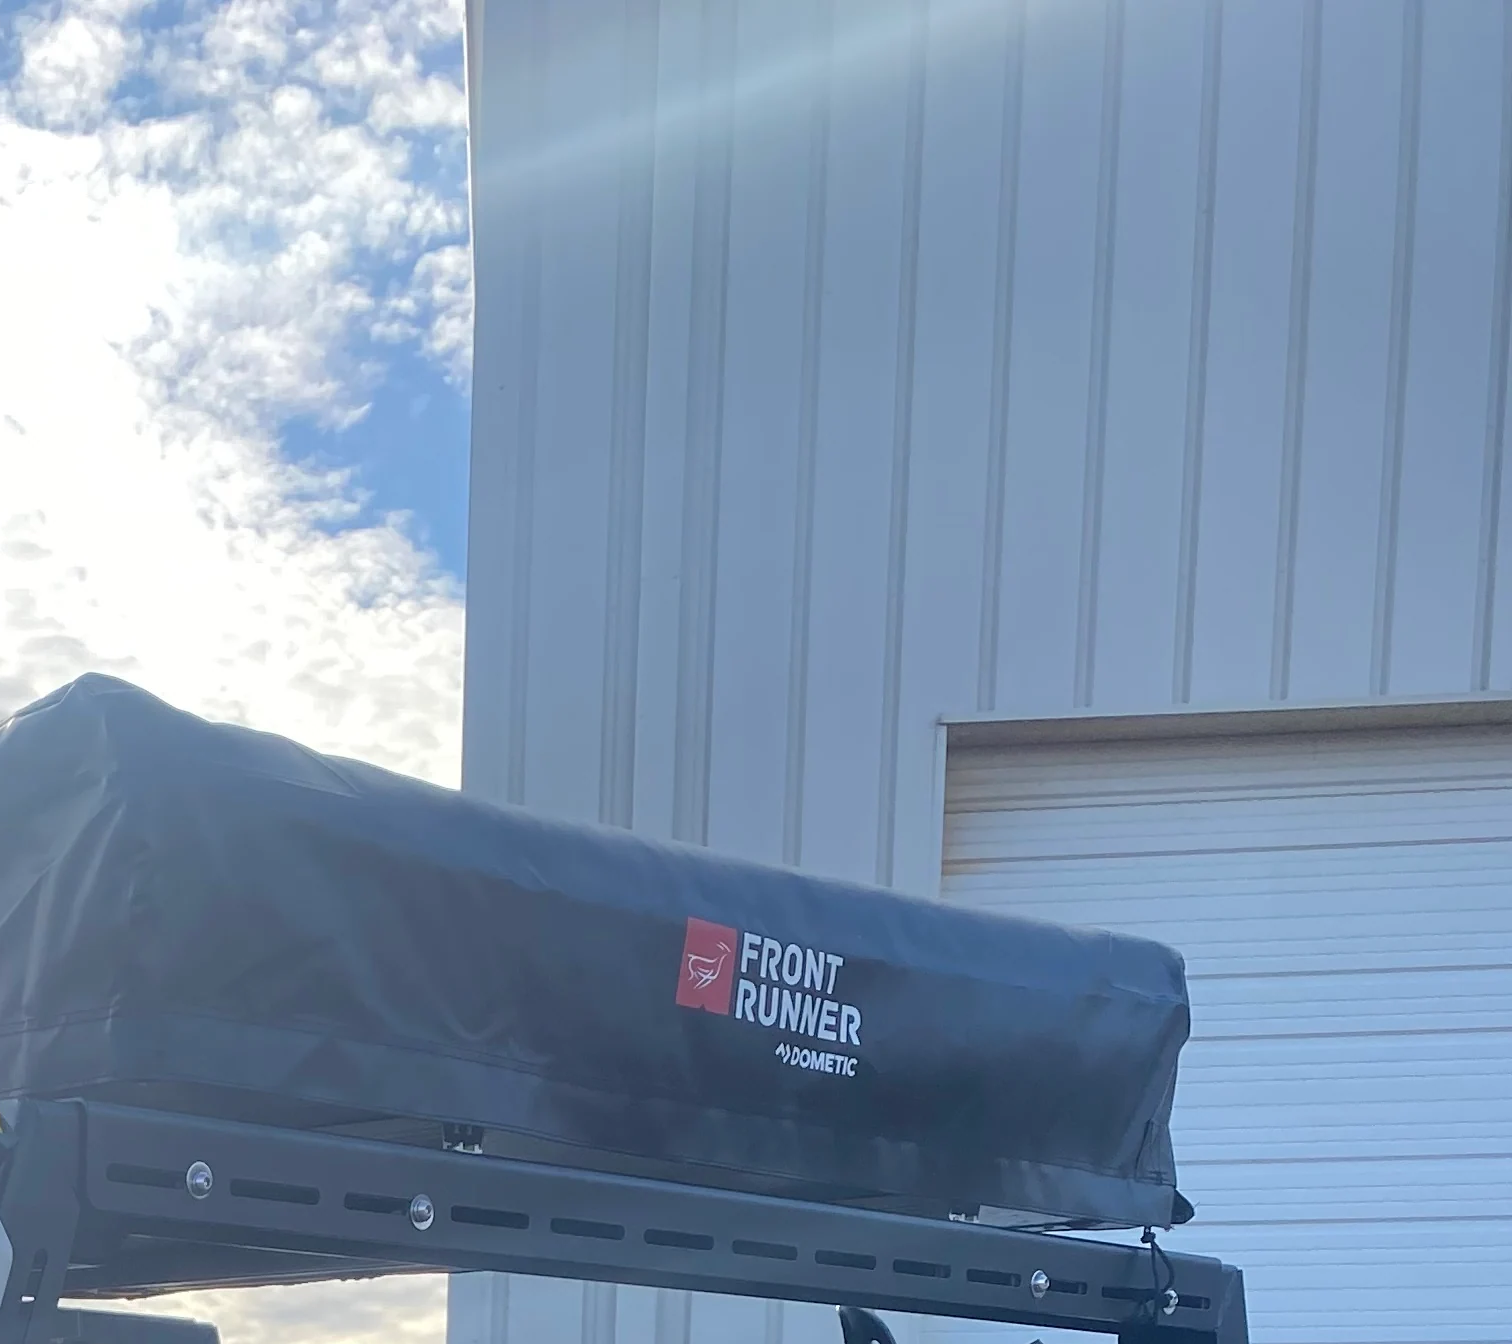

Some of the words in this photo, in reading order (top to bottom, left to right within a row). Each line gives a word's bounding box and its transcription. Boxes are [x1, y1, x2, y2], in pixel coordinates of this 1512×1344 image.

[740, 931, 845, 995] FRONT
[734, 978, 863, 1047] RUNNER
[790, 1045, 859, 1077] DOMETIC
